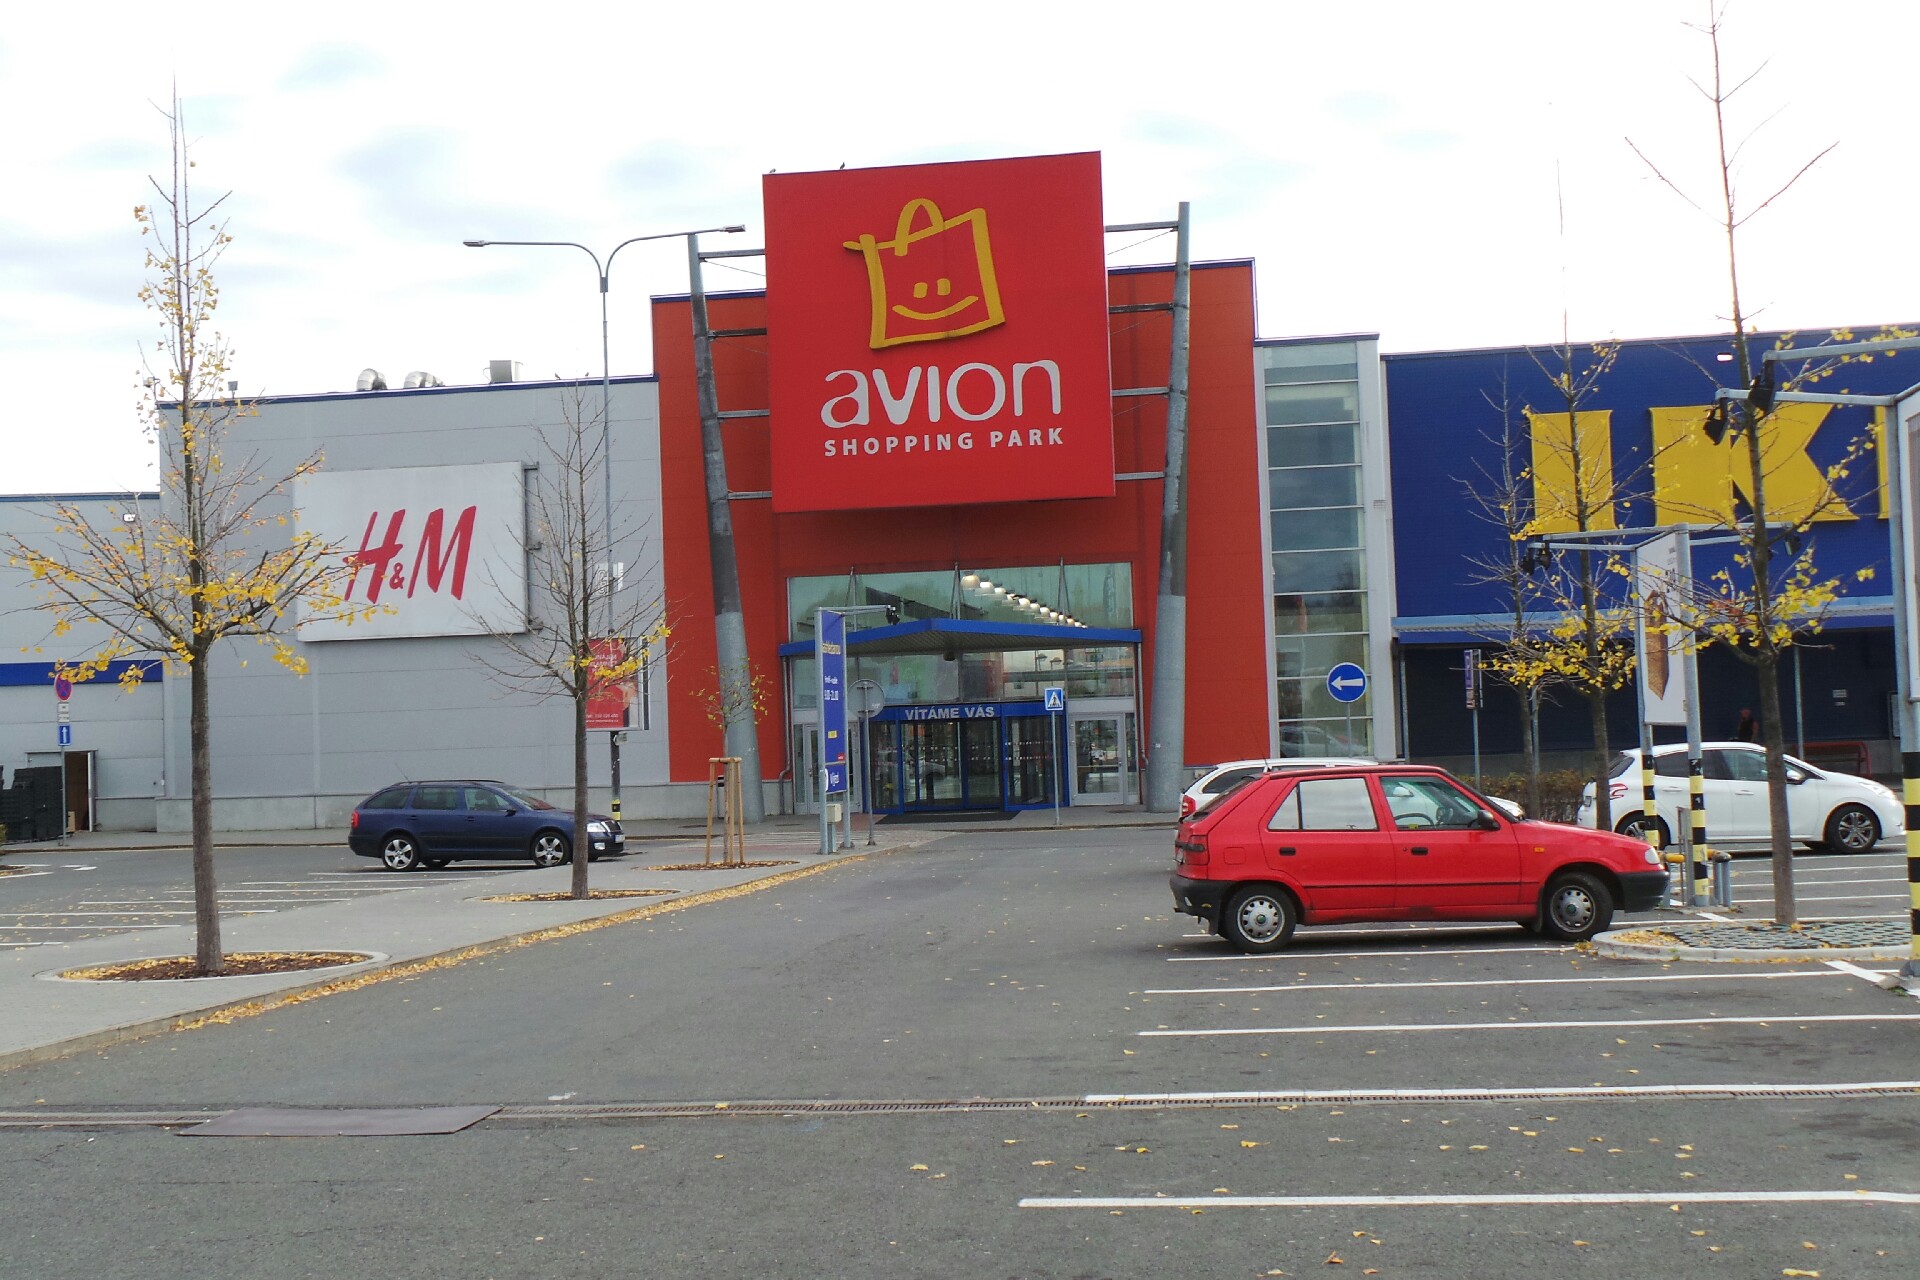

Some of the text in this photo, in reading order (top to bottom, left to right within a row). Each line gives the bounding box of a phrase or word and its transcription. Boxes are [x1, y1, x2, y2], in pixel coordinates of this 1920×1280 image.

[824, 428, 1063, 457] SHOPPING PARK
[342, 505, 477, 604] H&M
[904, 705, 995, 720] VÍTÁME VÁS
